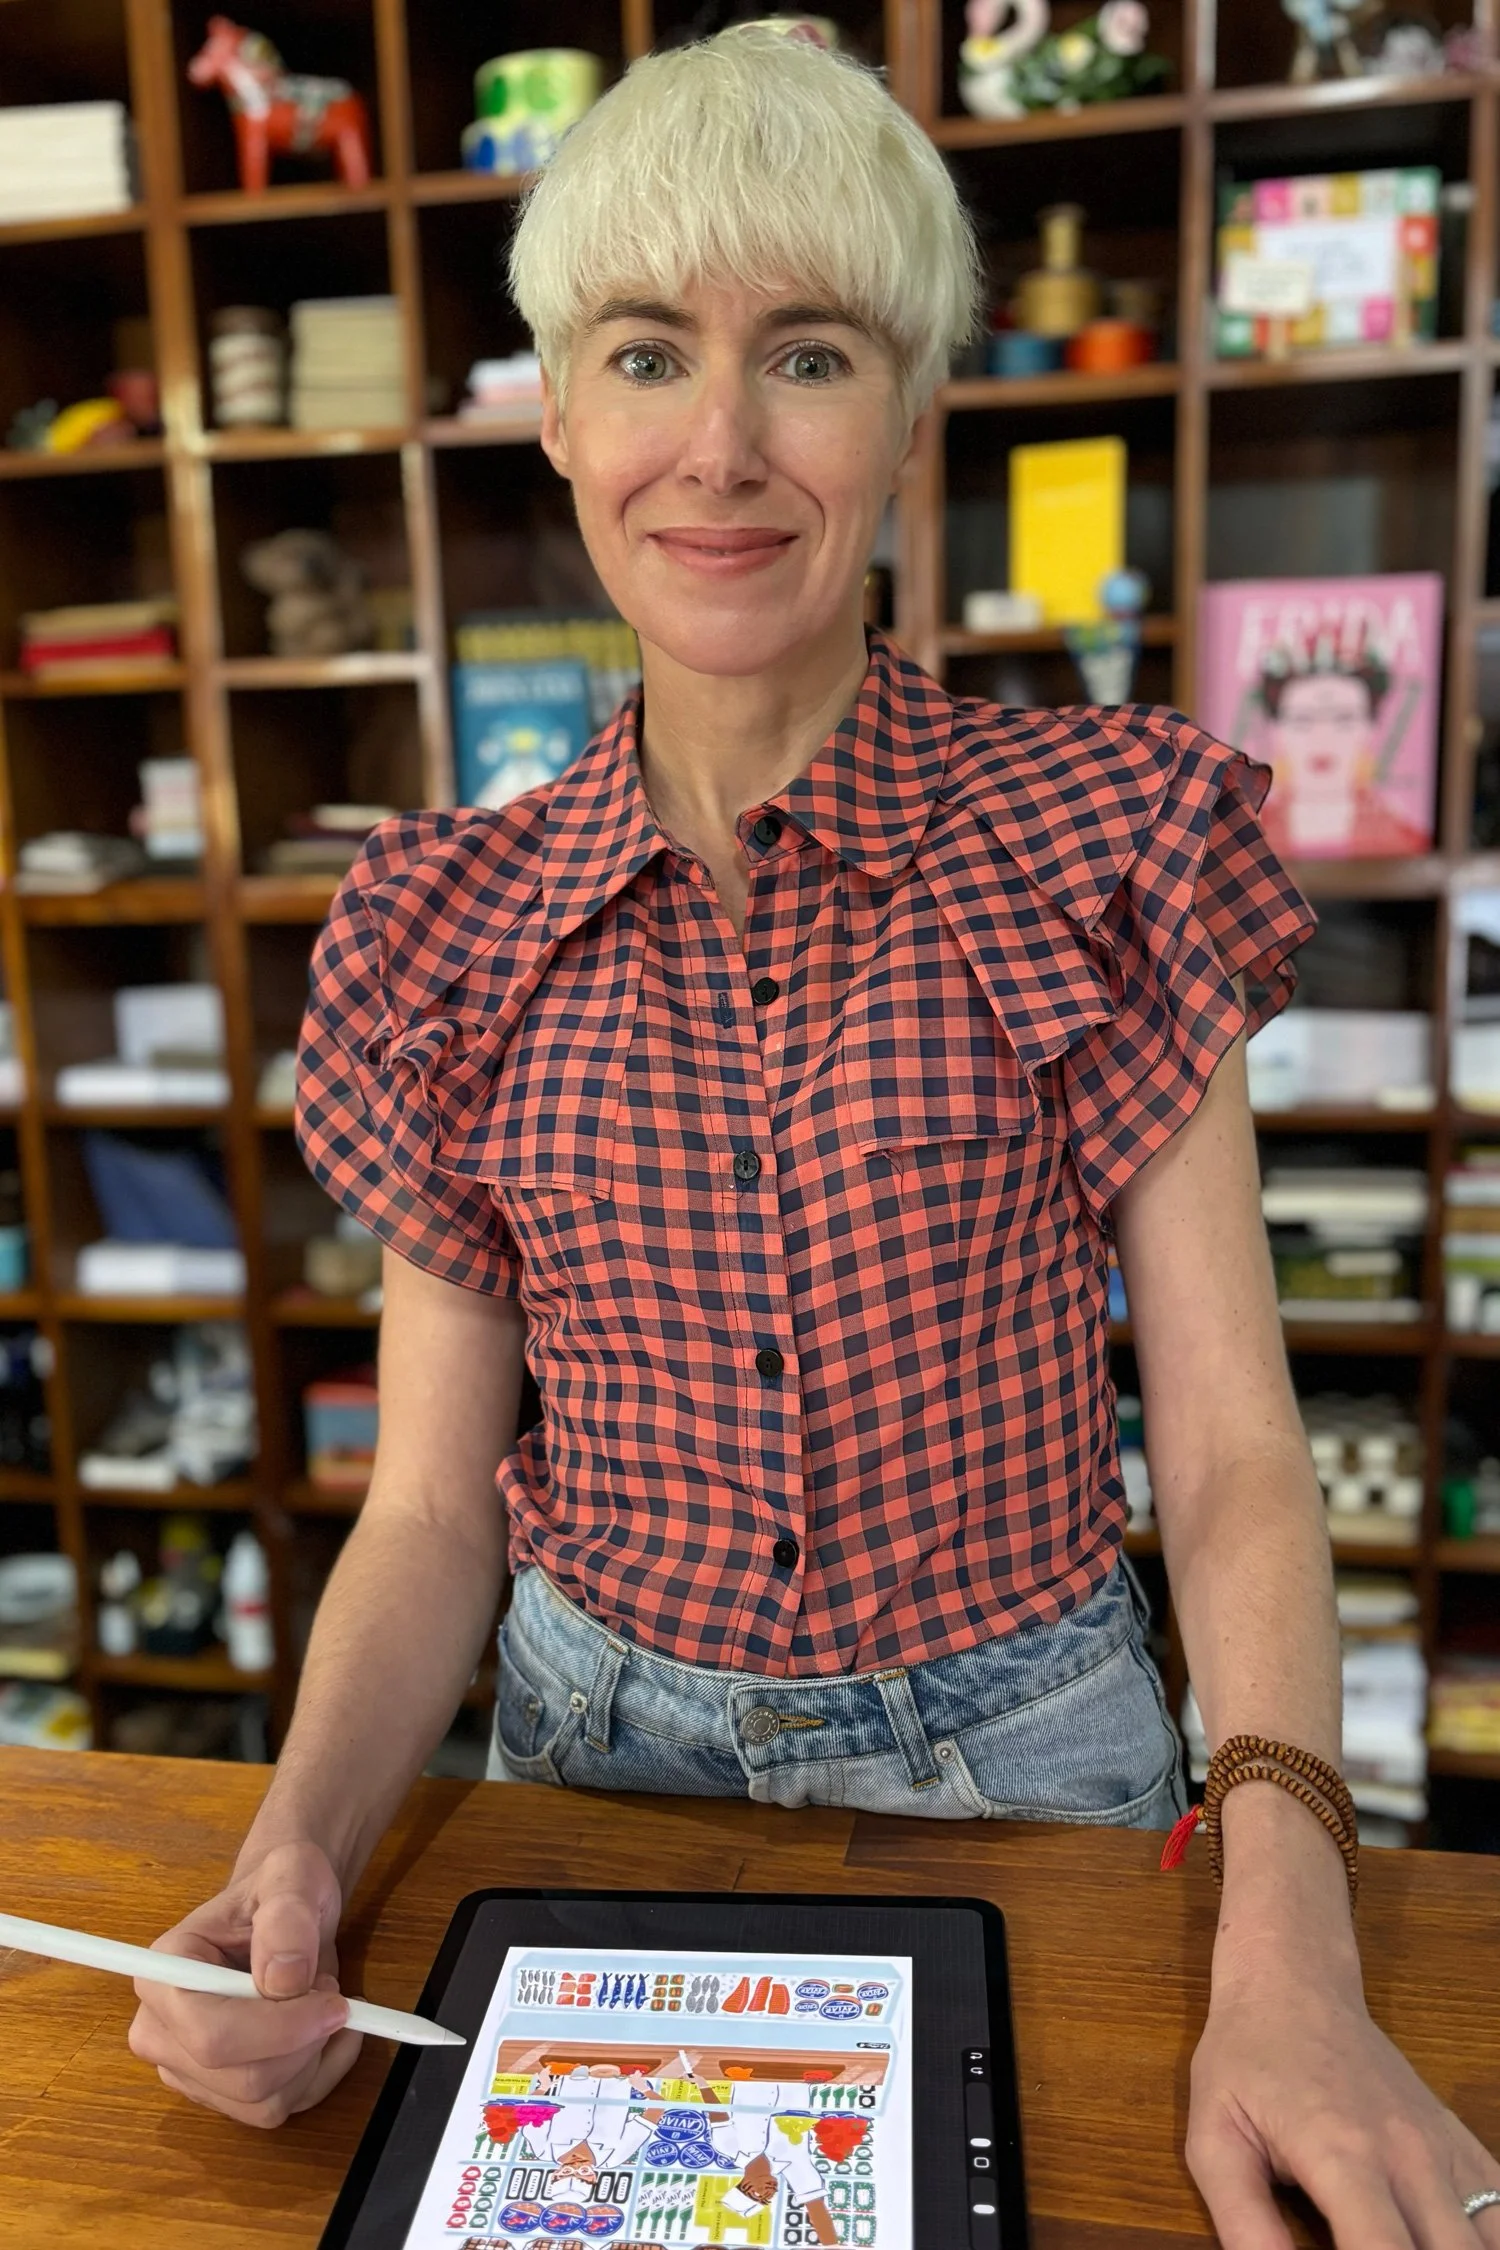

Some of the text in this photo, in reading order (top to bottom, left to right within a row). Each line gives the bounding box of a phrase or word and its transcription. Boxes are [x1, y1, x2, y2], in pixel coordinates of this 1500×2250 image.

[1238, 597, 1421, 678] FRIDA
[824, 2006, 858, 2014] CAVIAR
[657, 2115, 703, 2132] CAVIAR
